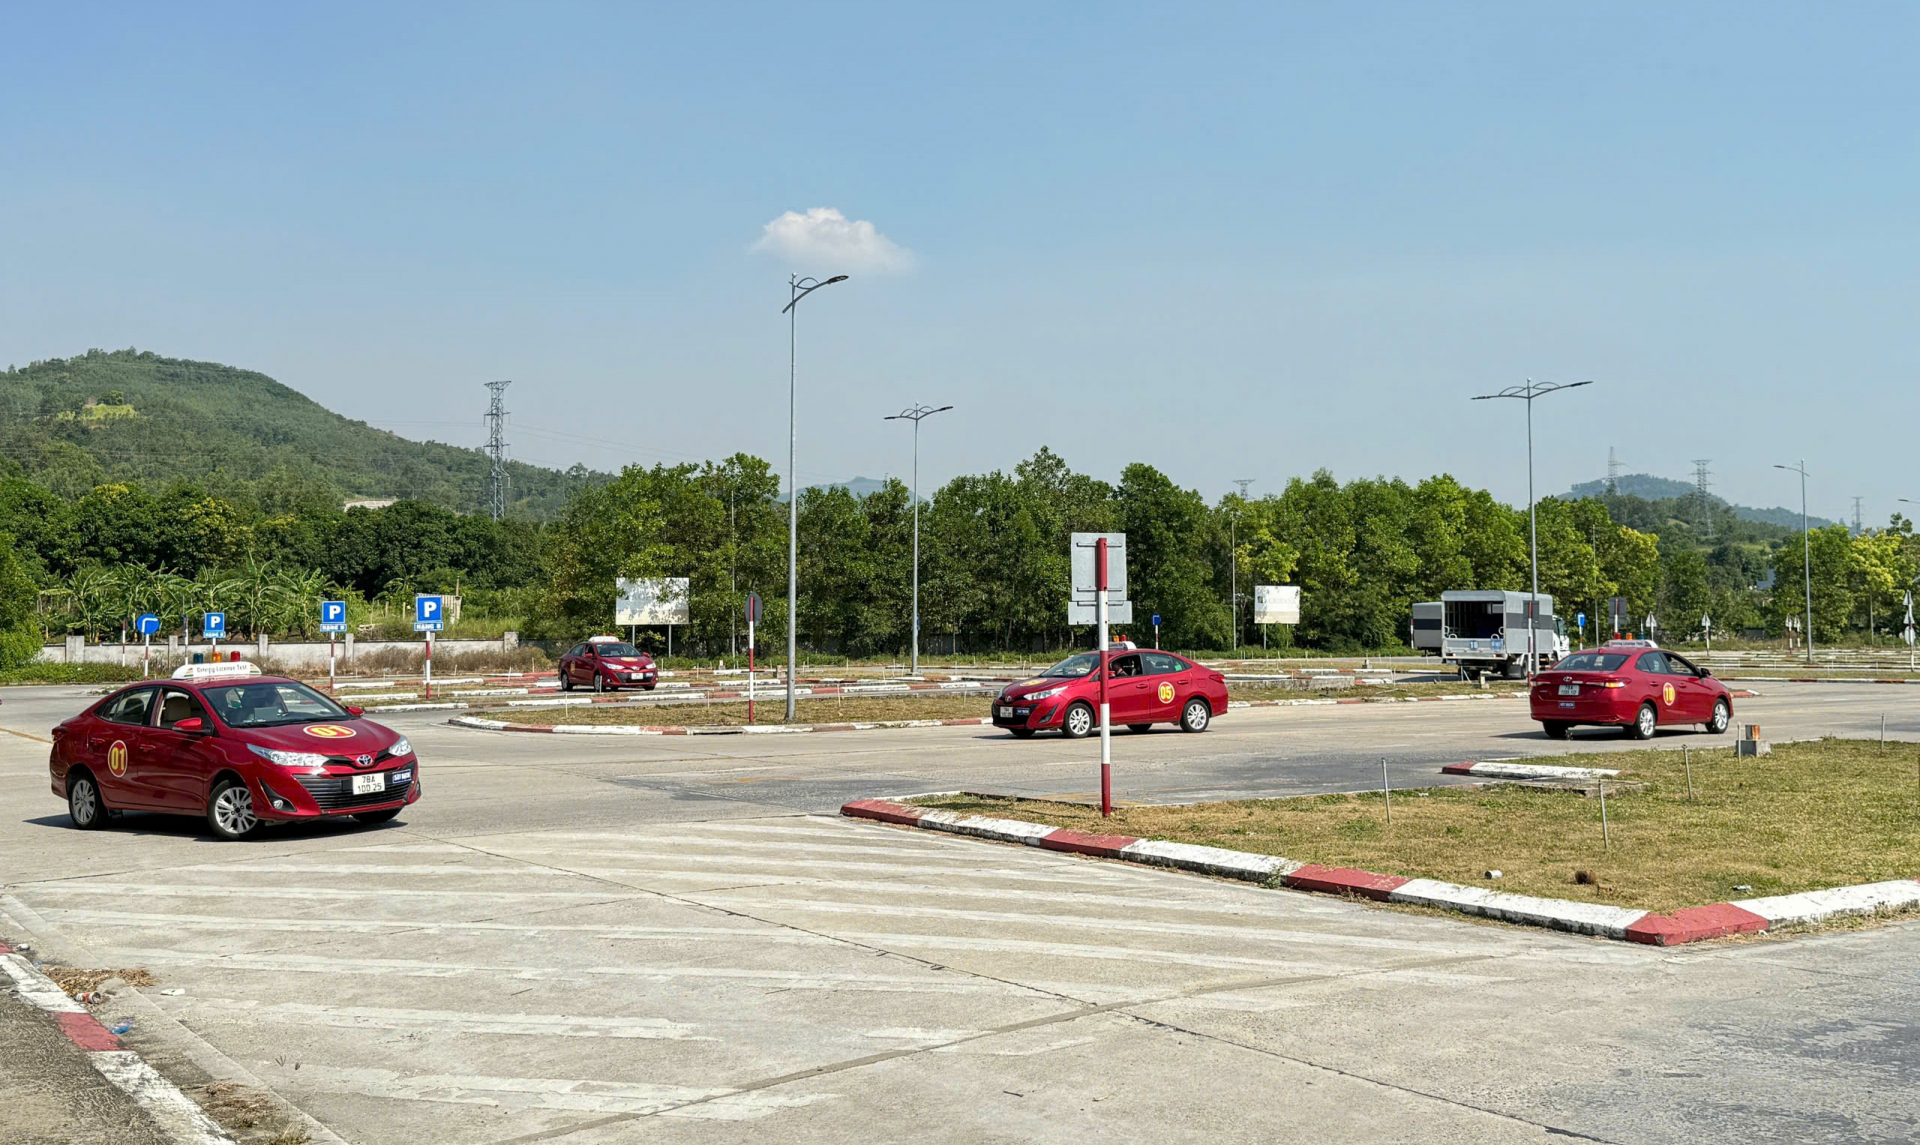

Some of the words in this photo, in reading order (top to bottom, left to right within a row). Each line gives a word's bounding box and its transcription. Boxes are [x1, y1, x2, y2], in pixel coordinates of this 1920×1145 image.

[329, 605, 341, 620] P
[424, 601, 437, 618] P
[211, 616, 221, 629] P
[1160, 685, 1172, 700] 05
[311, 725, 350, 736] 01
[111, 747, 125, 771] 01
[362, 775, 376, 783] 78A
